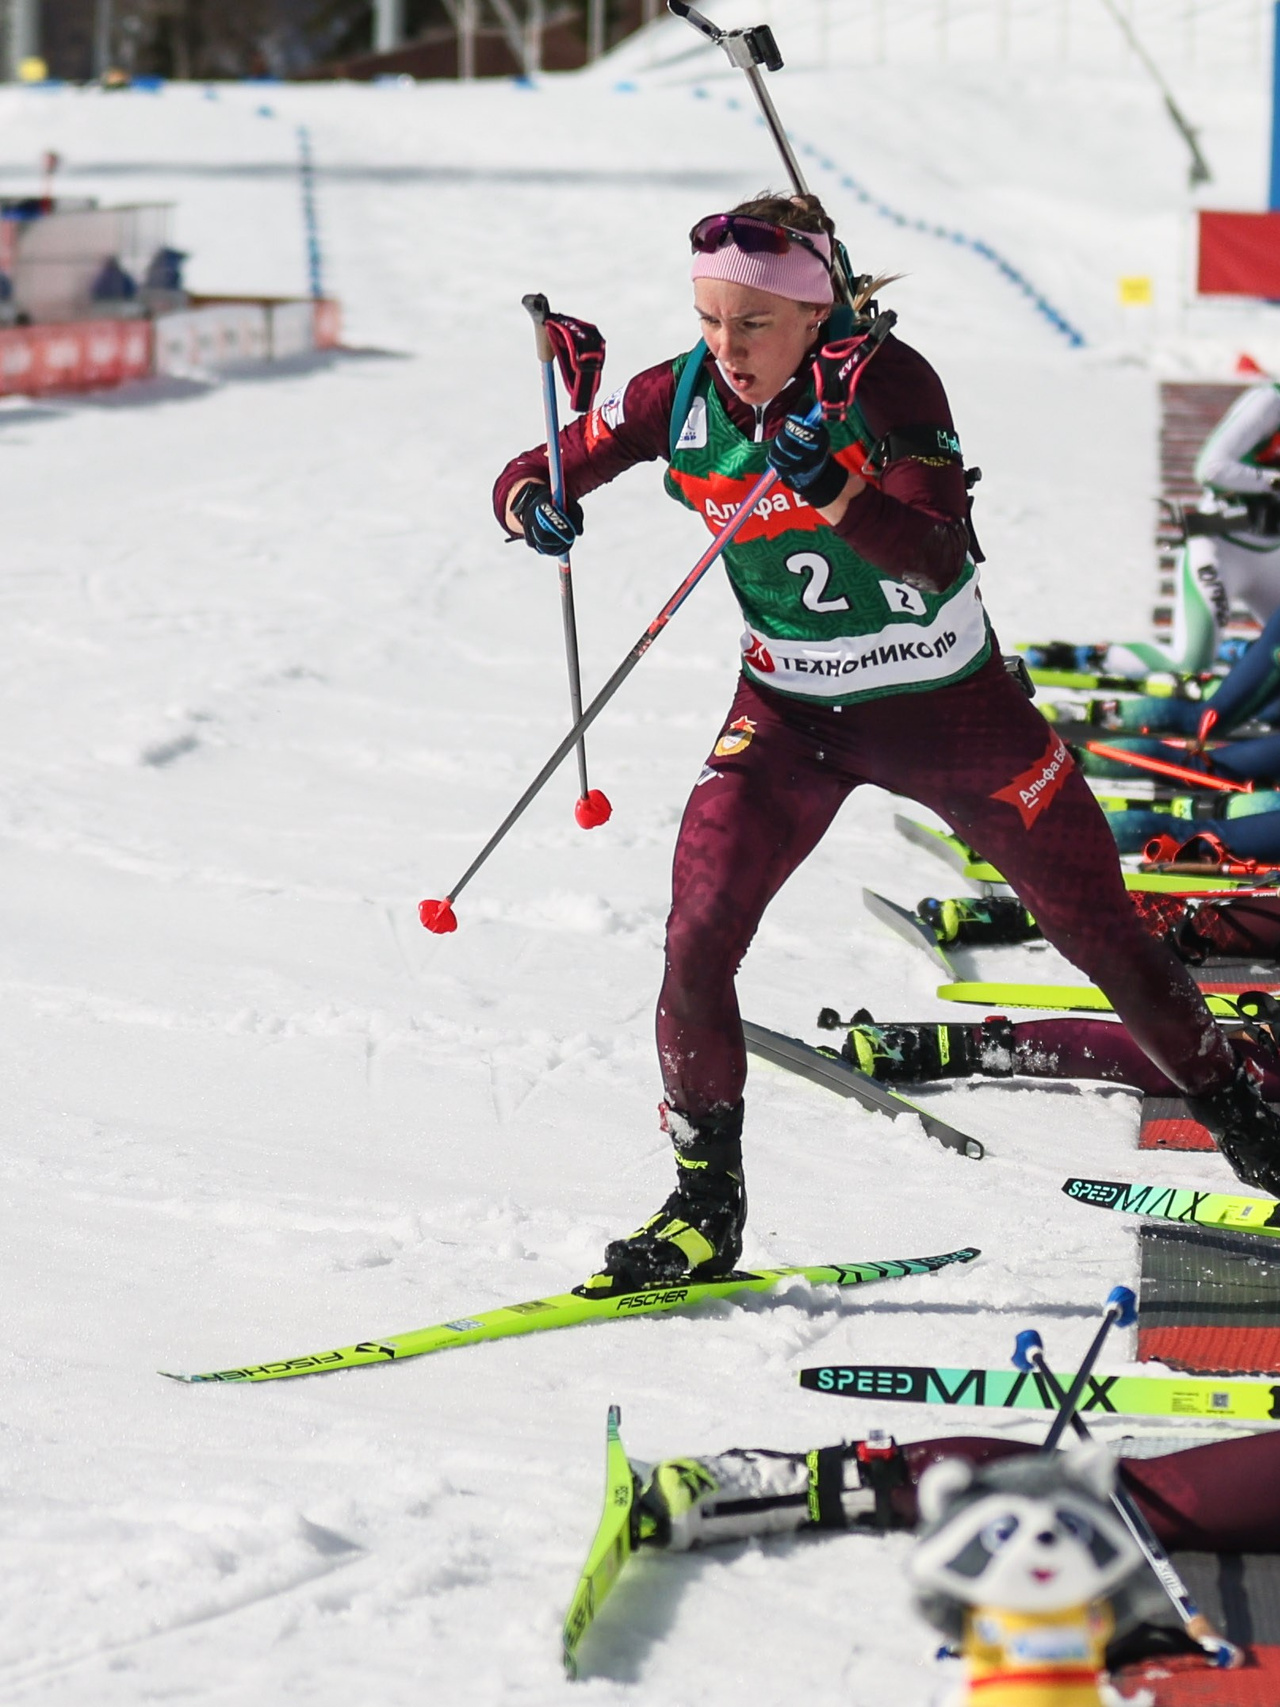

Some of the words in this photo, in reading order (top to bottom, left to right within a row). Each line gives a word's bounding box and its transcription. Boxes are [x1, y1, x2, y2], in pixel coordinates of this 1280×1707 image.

[838, 351, 861, 381] KV+
[705, 493, 790, 526] Алфа
[785, 551, 850, 613] 2
[896, 588, 915, 610] 2
[780, 630, 958, 678] ТЕХНОНИКОЛЬ
[1019, 760, 1060, 808] Альфа
[1068, 1180, 1117, 1203] SPEED
[1113, 1183, 1211, 1222] MAX
[616, 1289, 689, 1311] FISCHER
[818, 1368, 913, 1394] SPEED
[926, 1366, 1119, 1413] MAX
